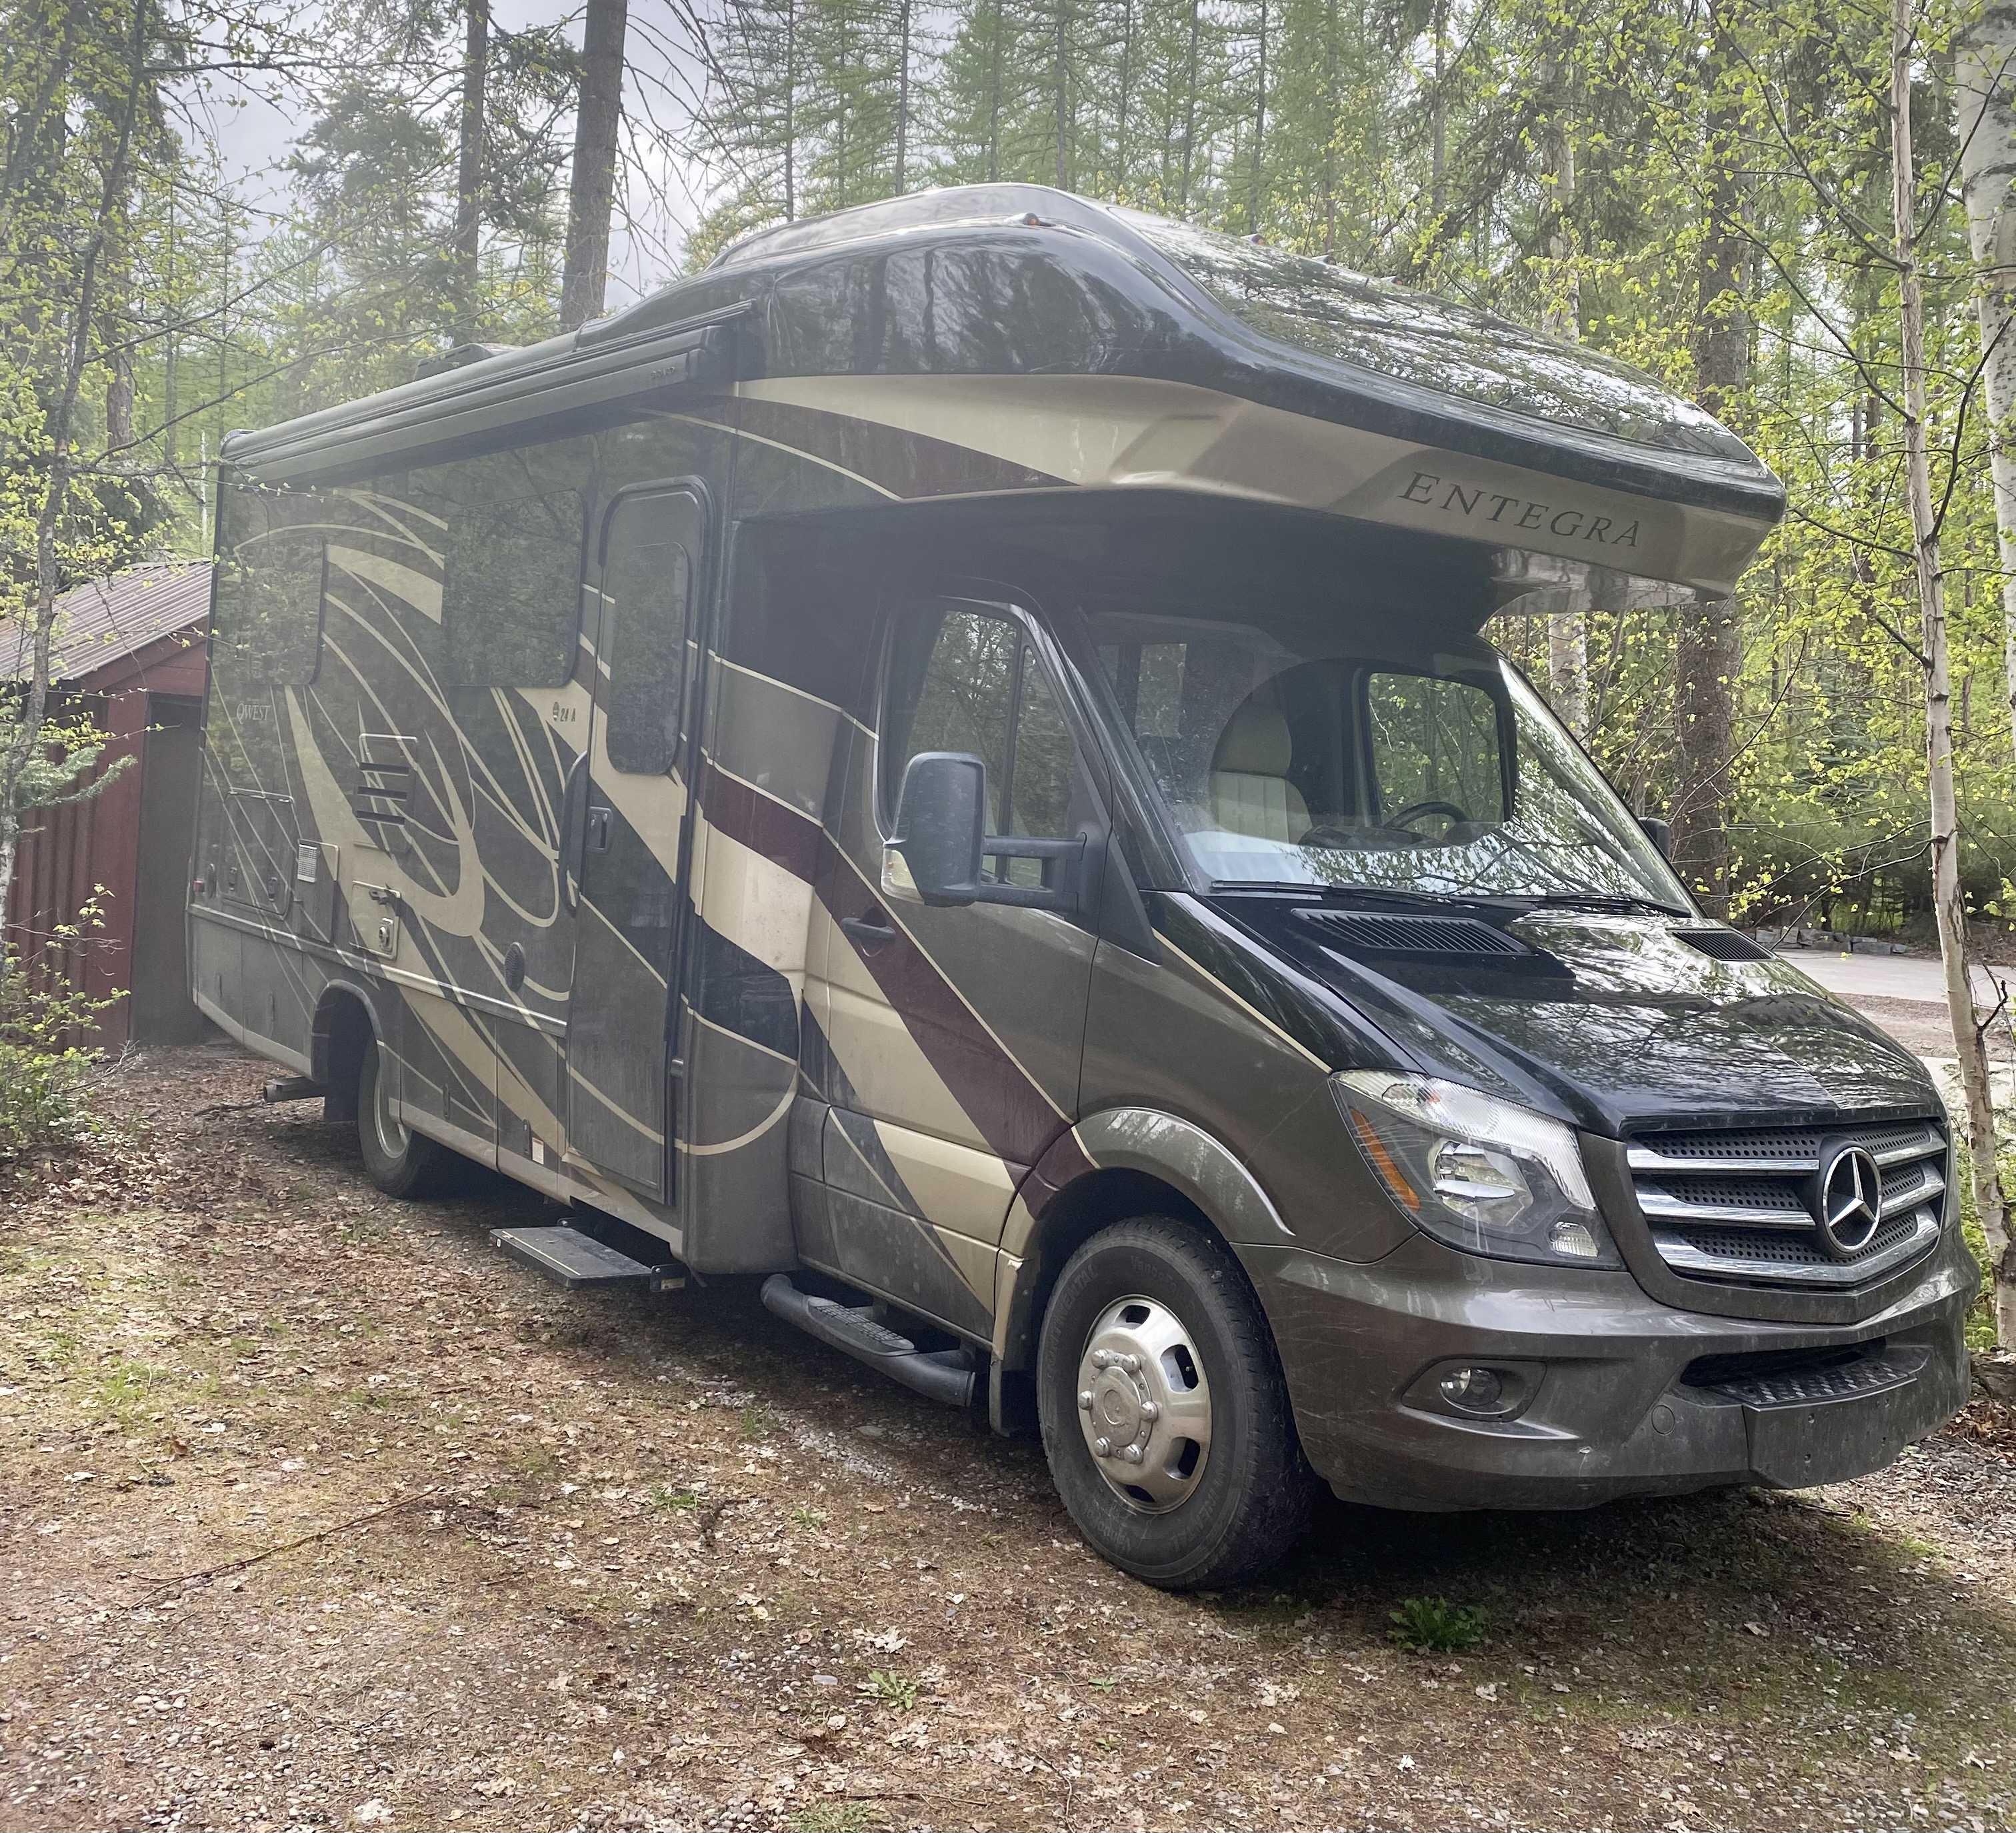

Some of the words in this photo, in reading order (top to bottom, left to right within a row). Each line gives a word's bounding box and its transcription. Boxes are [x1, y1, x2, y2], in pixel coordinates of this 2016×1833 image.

[1397, 471, 1639, 547] ENTEGRA
[236, 703, 272, 725] QWEST
[560, 707, 569, 722] 24
